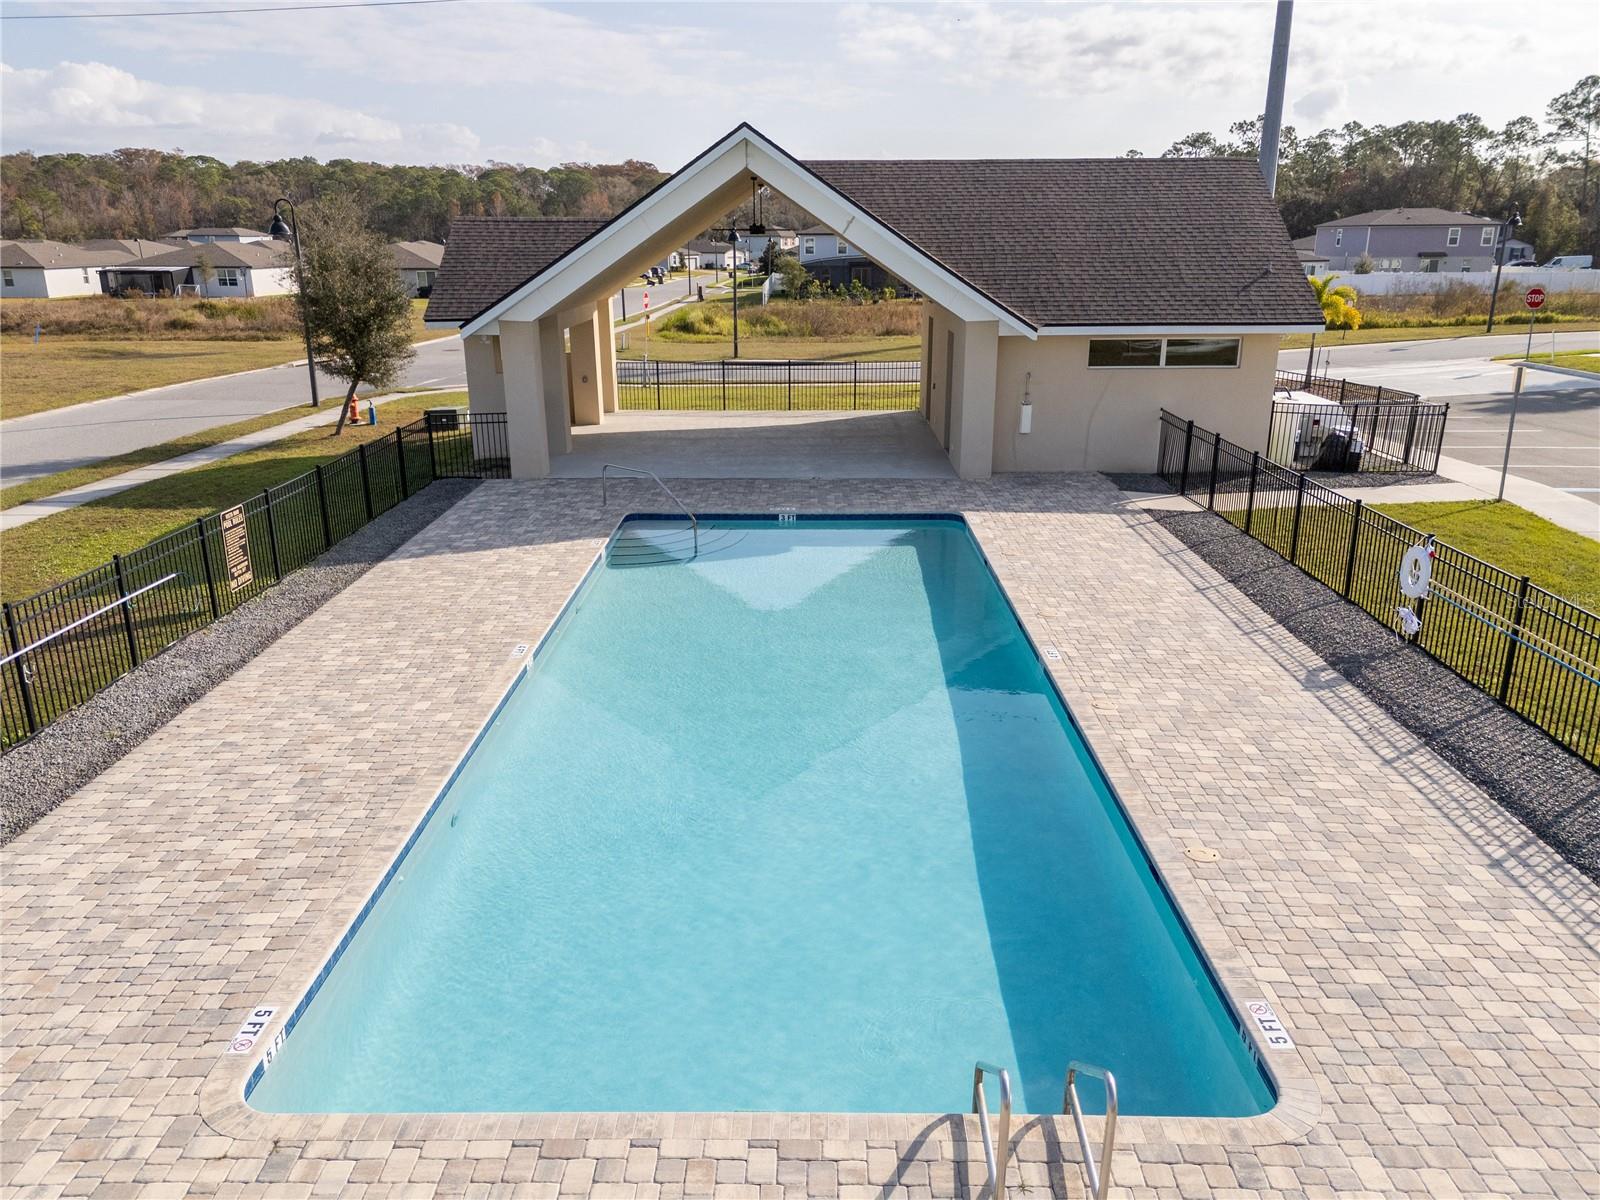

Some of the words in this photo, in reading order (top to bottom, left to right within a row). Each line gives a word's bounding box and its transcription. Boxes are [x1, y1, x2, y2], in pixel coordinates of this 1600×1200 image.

[1527, 294, 1545, 303] STOP
[254, 1009, 274, 1017] 5
[241, 1022, 265, 1036] FT
[1257, 1017, 1282, 1031] FT
[266, 1047, 273, 1064] 5
[274, 1027, 284, 1052] FT
[1269, 1036, 1288, 1044] 5
